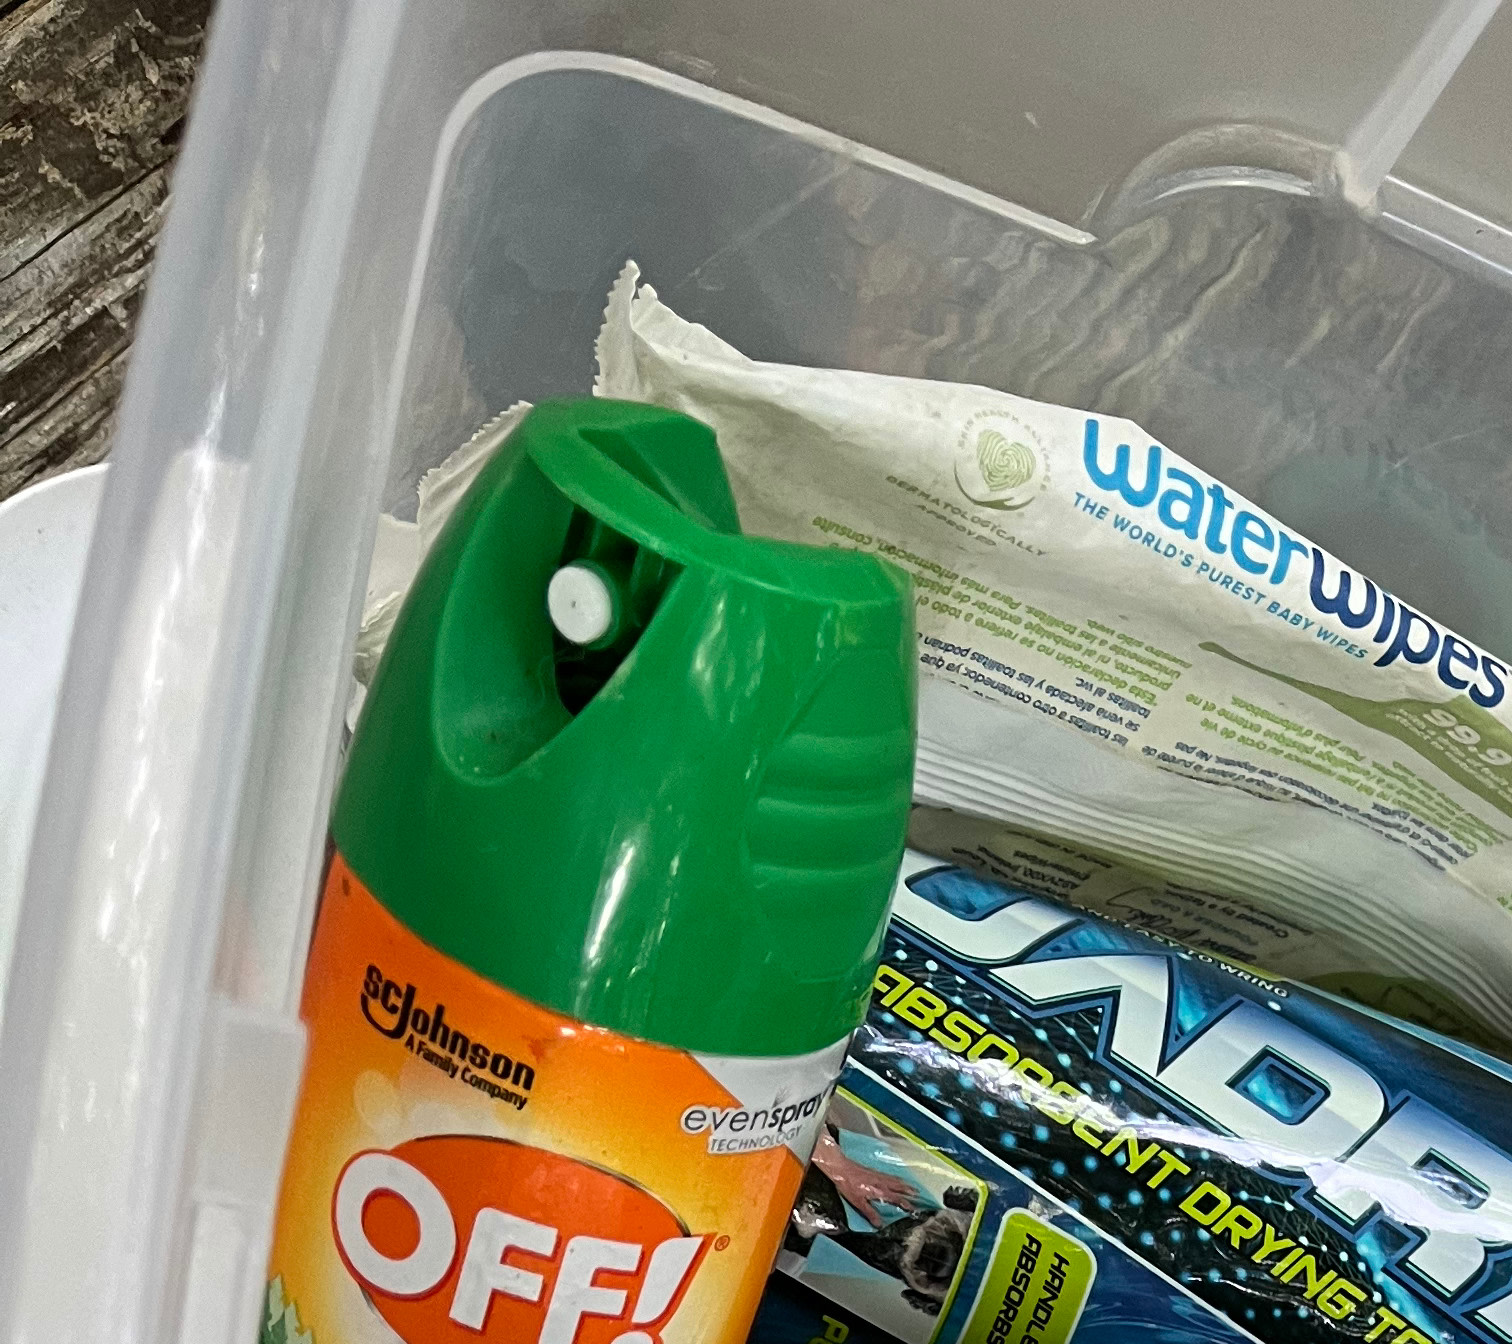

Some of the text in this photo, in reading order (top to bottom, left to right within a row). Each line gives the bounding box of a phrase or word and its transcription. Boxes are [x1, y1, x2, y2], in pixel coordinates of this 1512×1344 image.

[1074, 491, 1368, 661] THE WORLD'S PUREST BABY WIPES
[1219, 962, 1289, 998] WRING
[416, 1039, 528, 1111] Family Company
[870, 963, 1191, 1189] ABSORBENT
[1181, 1179, 1369, 1324] DRYING
